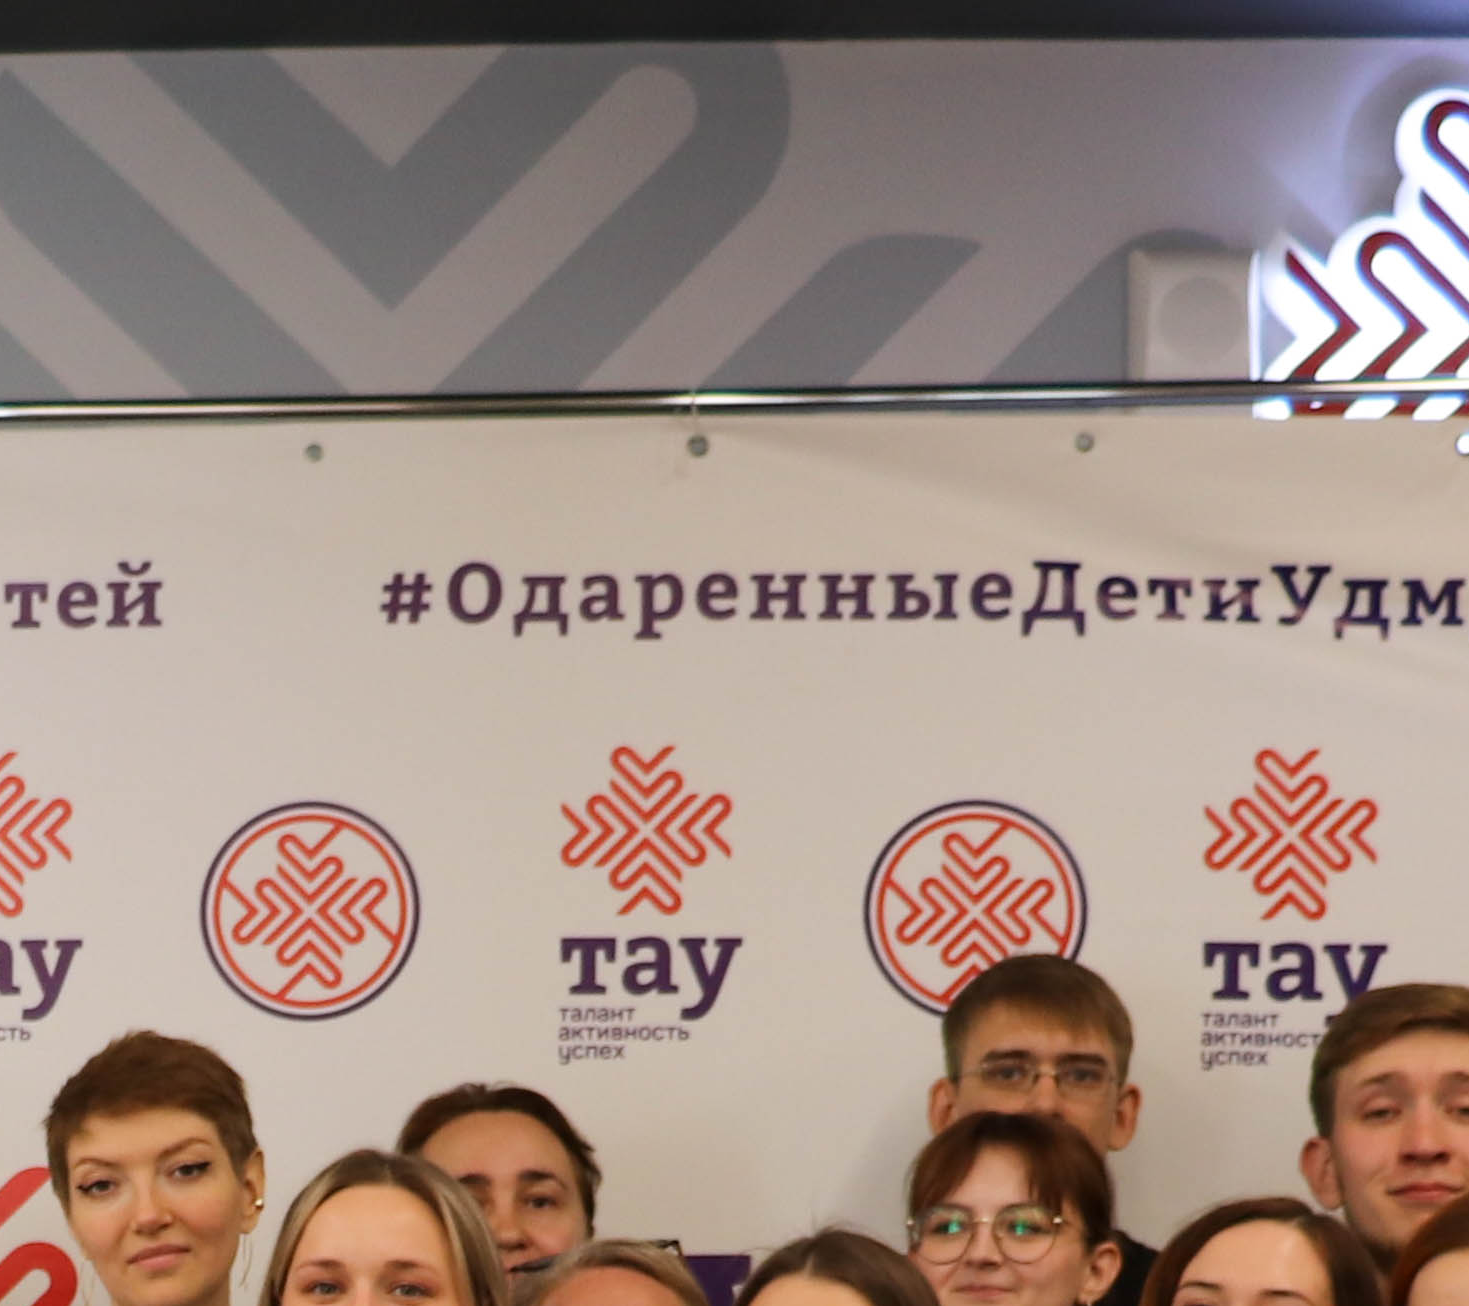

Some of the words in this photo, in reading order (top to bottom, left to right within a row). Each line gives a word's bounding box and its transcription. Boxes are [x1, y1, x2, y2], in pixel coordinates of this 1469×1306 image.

[560, 935, 743, 1021] тау
[559, 1006, 636, 1023] талант
[1201, 1012, 1279, 1028] талант
[557, 1025, 691, 1042] активность
[1200, 1031, 1323, 1048] активност
[557, 1043, 626, 1066] успех
[1200, 1050, 1268, 1073] успех
